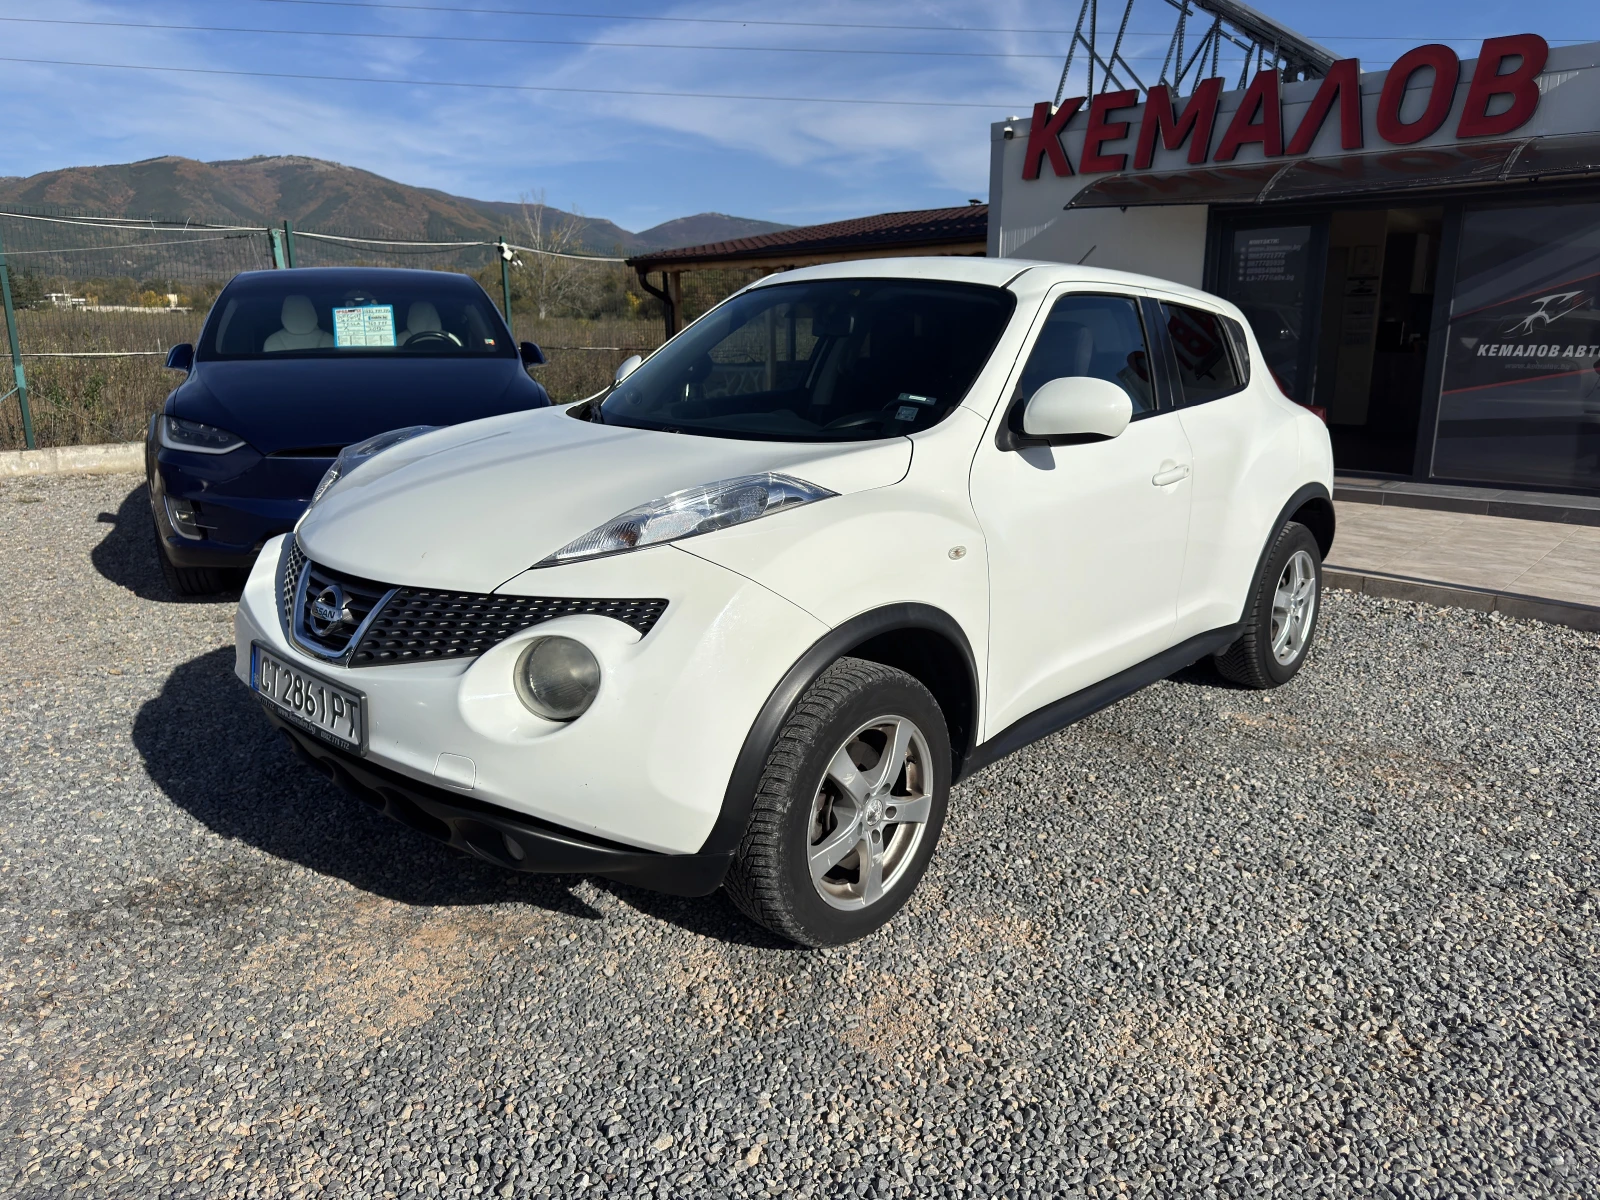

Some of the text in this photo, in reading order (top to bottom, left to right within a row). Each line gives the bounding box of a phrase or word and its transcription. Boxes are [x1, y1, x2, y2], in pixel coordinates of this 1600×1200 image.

[1021, 33, 1549, 181] КЕМАЛОВ
[1477, 344, 1600, 358] КЕМАЛОВ АВТ
